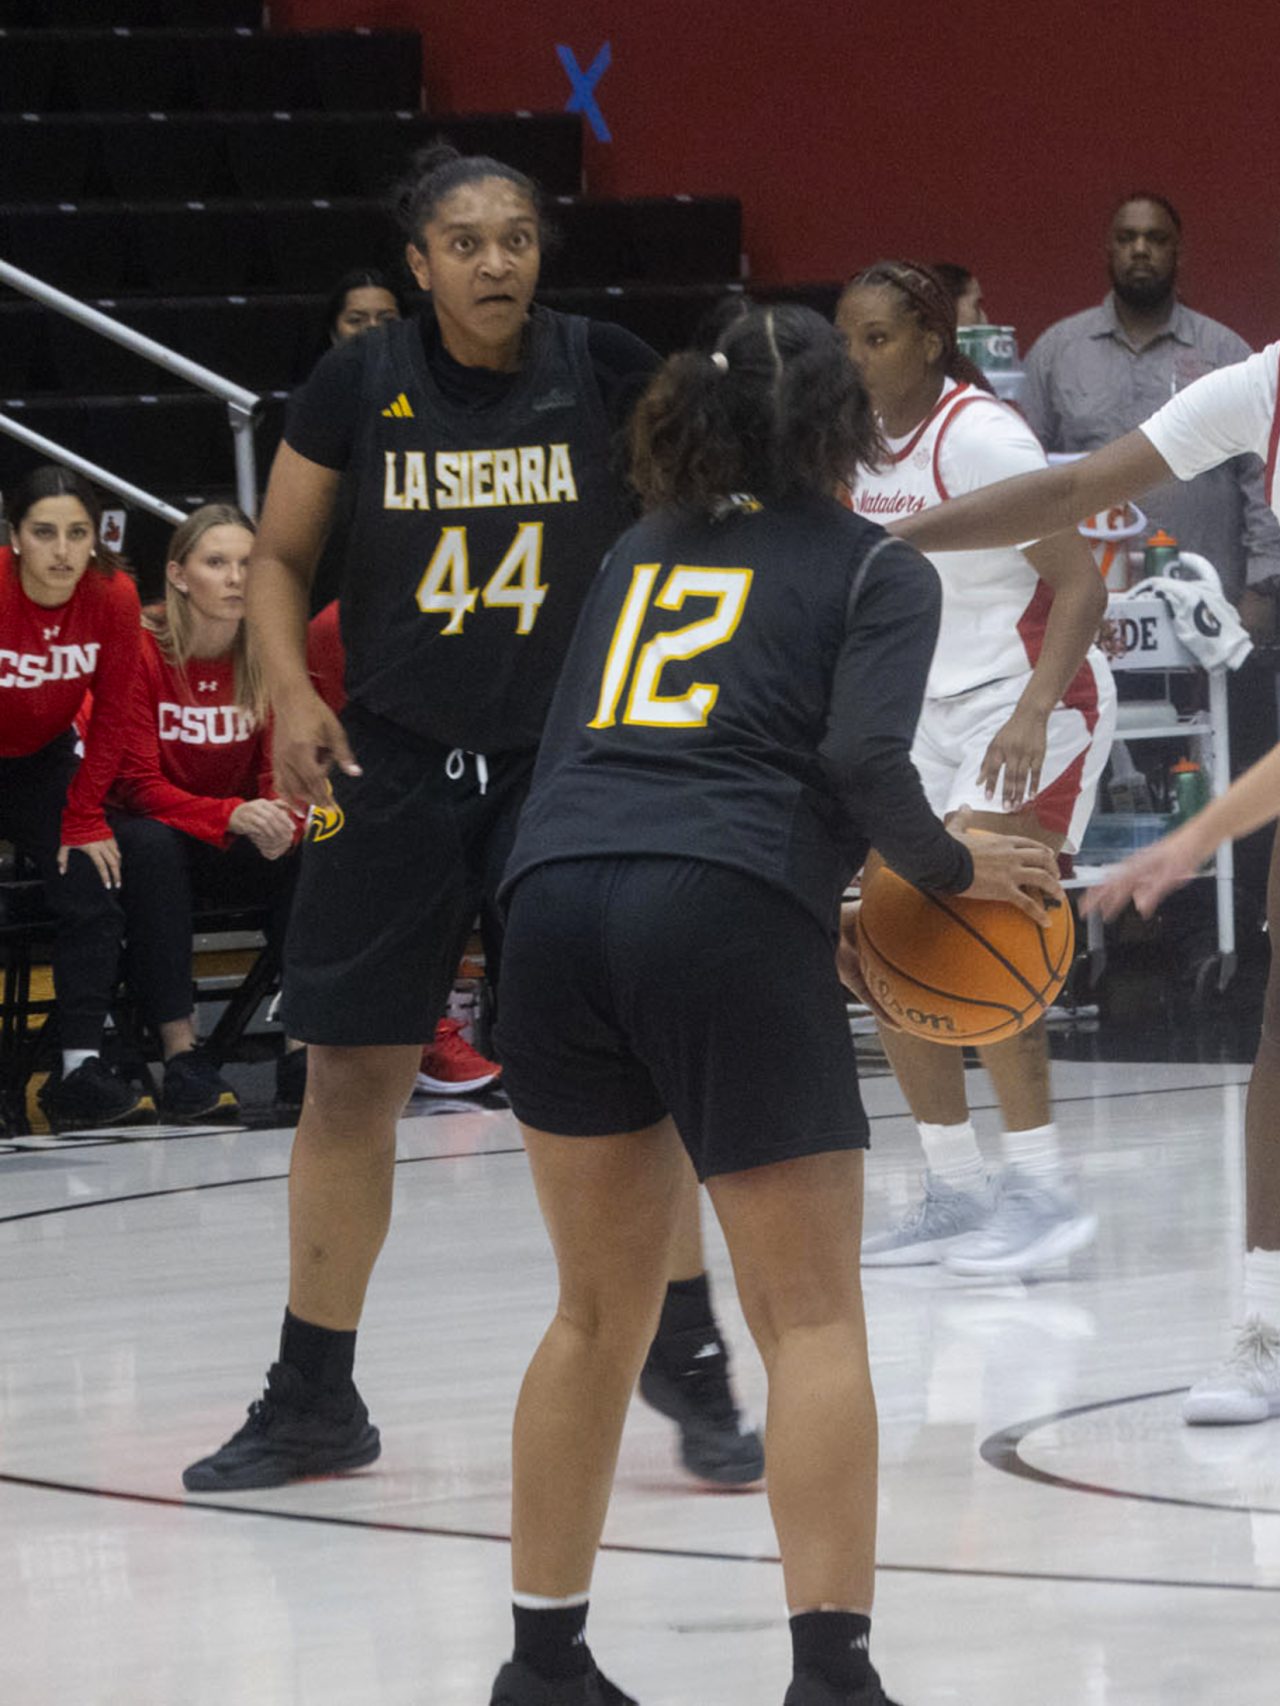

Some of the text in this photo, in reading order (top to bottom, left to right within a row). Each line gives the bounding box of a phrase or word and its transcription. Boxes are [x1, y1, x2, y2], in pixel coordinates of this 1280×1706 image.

[384, 443, 579, 511] LA SIERRA
[415, 521, 549, 636] 44
[586, 563, 754, 730] 12
[1116, 617, 1158, 652] DE
